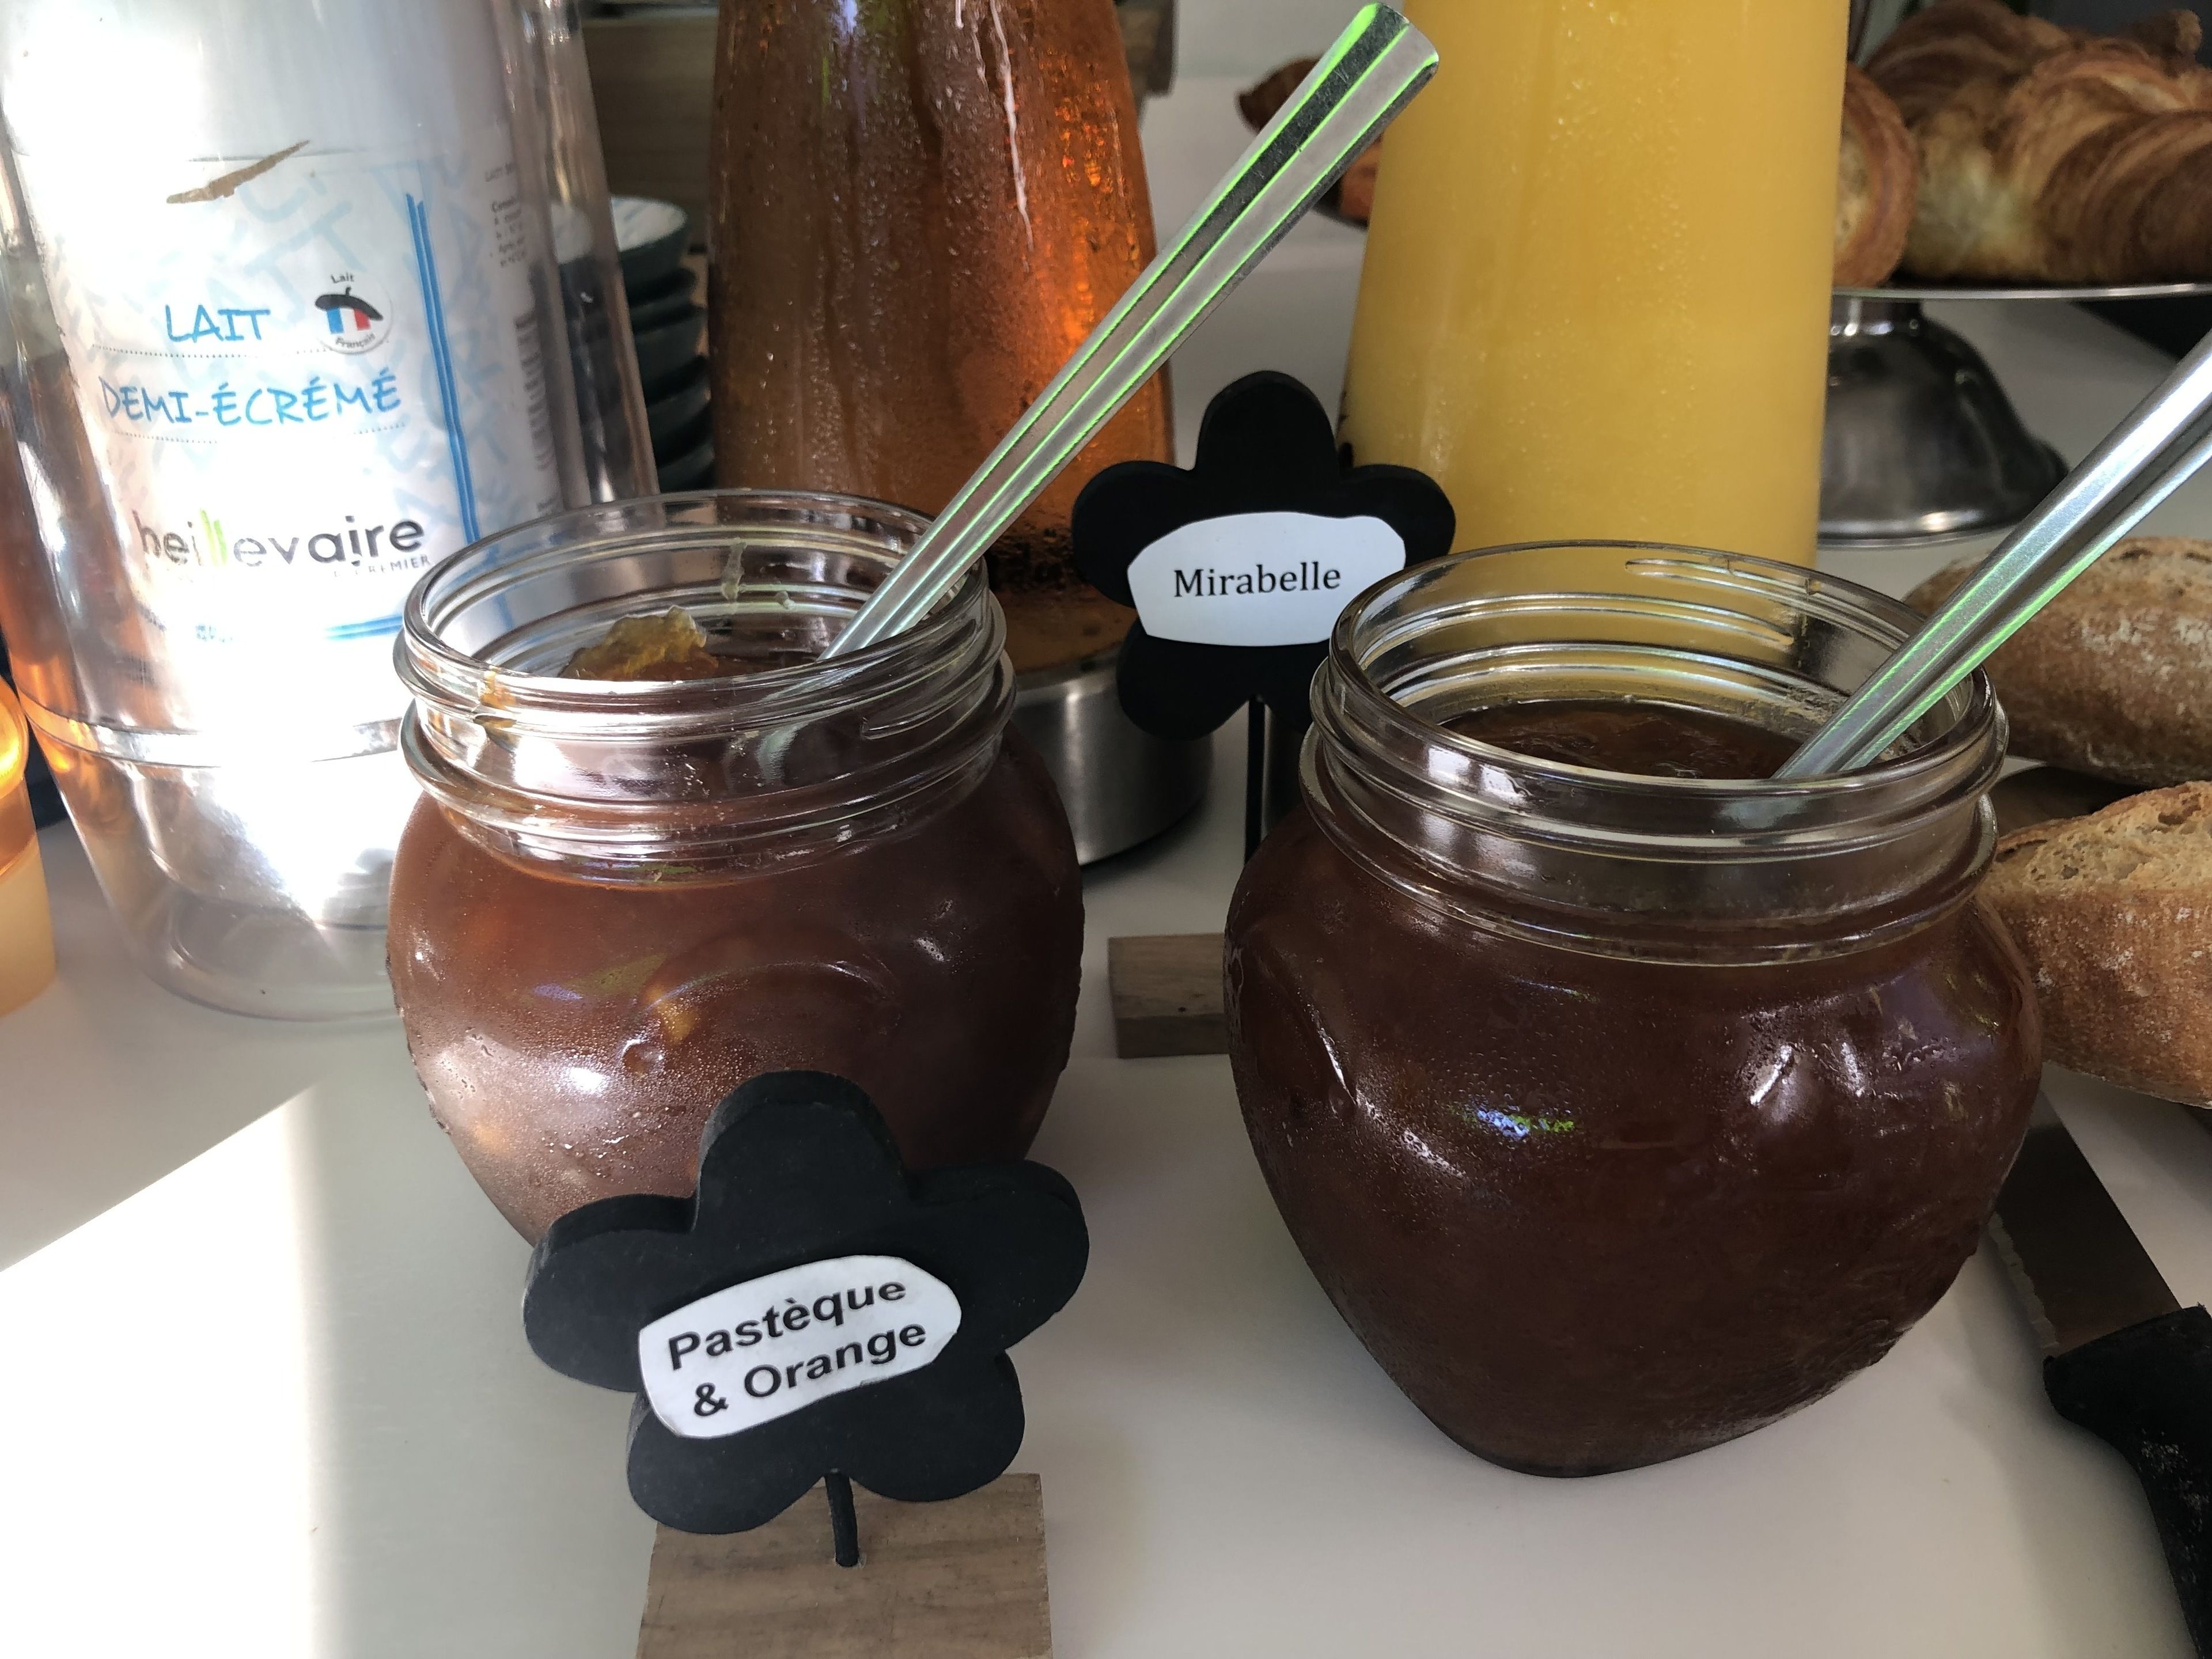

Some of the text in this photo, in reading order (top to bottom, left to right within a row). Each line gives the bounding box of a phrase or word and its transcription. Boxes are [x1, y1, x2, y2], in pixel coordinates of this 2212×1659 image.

[330, 271, 354, 283] Lait
[165, 304, 271, 343] LAIT
[98, 366, 402, 427] DEMI-ÉCRÉMÉ
[1173, 560, 1342, 598] Mirabelle
[668, 1281, 907, 1371] Pastèque
[693, 1323, 926, 1416] & Orange
